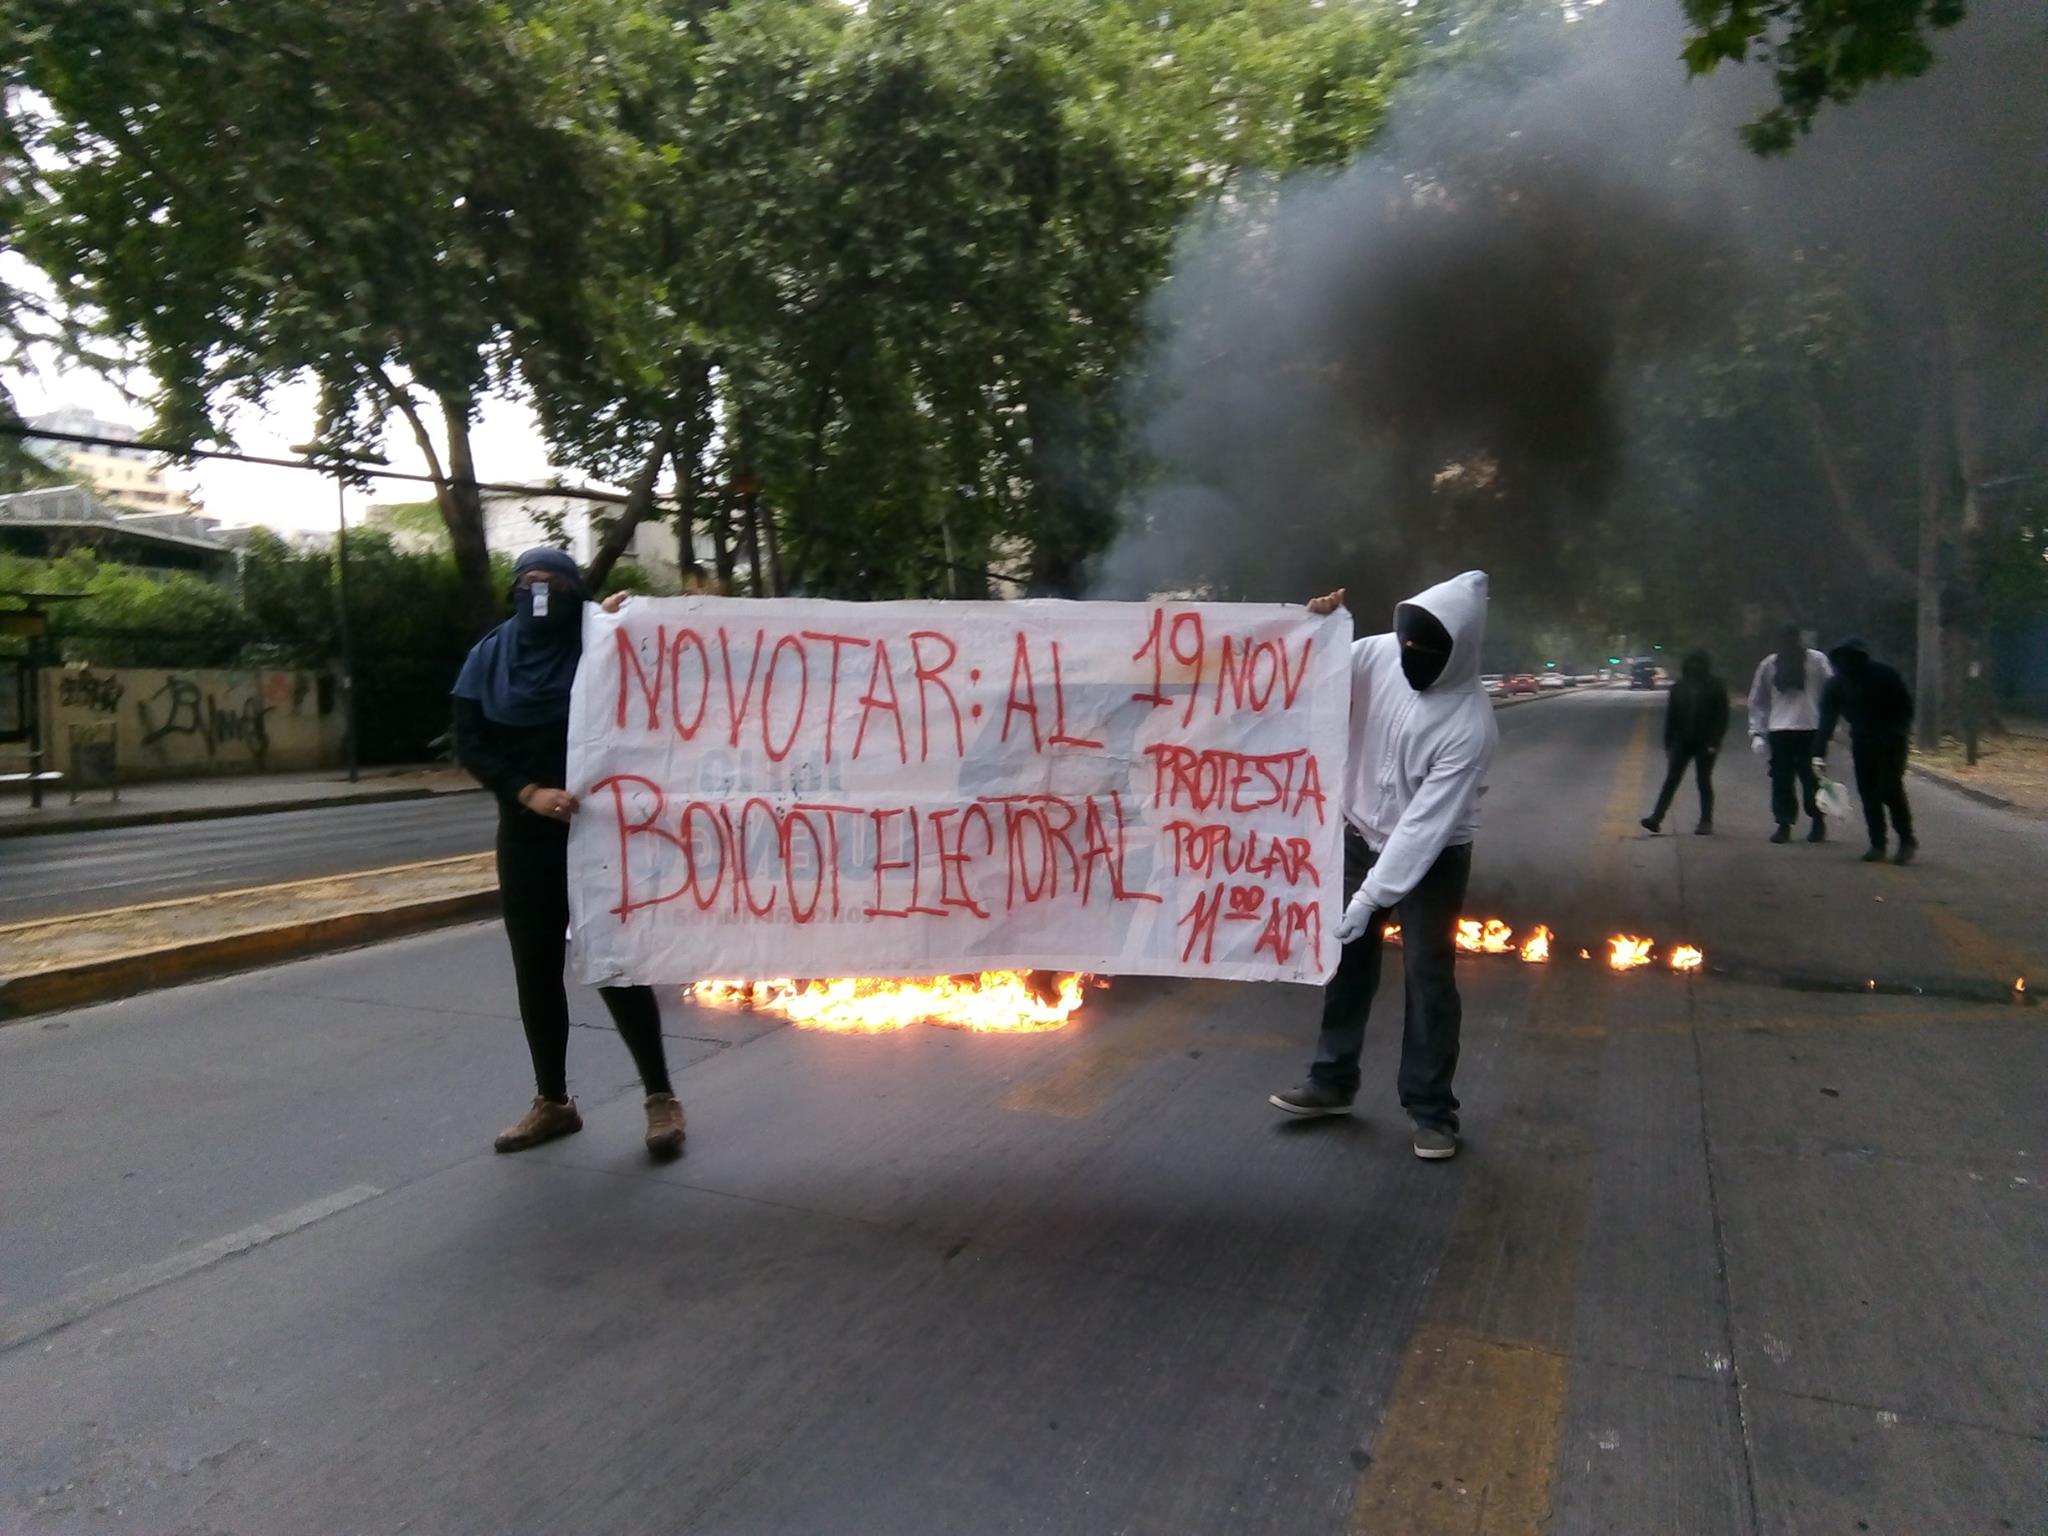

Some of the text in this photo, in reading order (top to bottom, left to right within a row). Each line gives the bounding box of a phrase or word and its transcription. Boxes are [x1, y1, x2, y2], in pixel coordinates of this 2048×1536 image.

[1001, 631, 1104, 753] AL
[1131, 608, 1204, 729] 19
[1213, 635, 1314, 716] NOV
[1143, 743, 1327, 825] PROTESTA
[1163, 820, 1320, 887] POPULAR
[1254, 897, 1324, 973] AM
